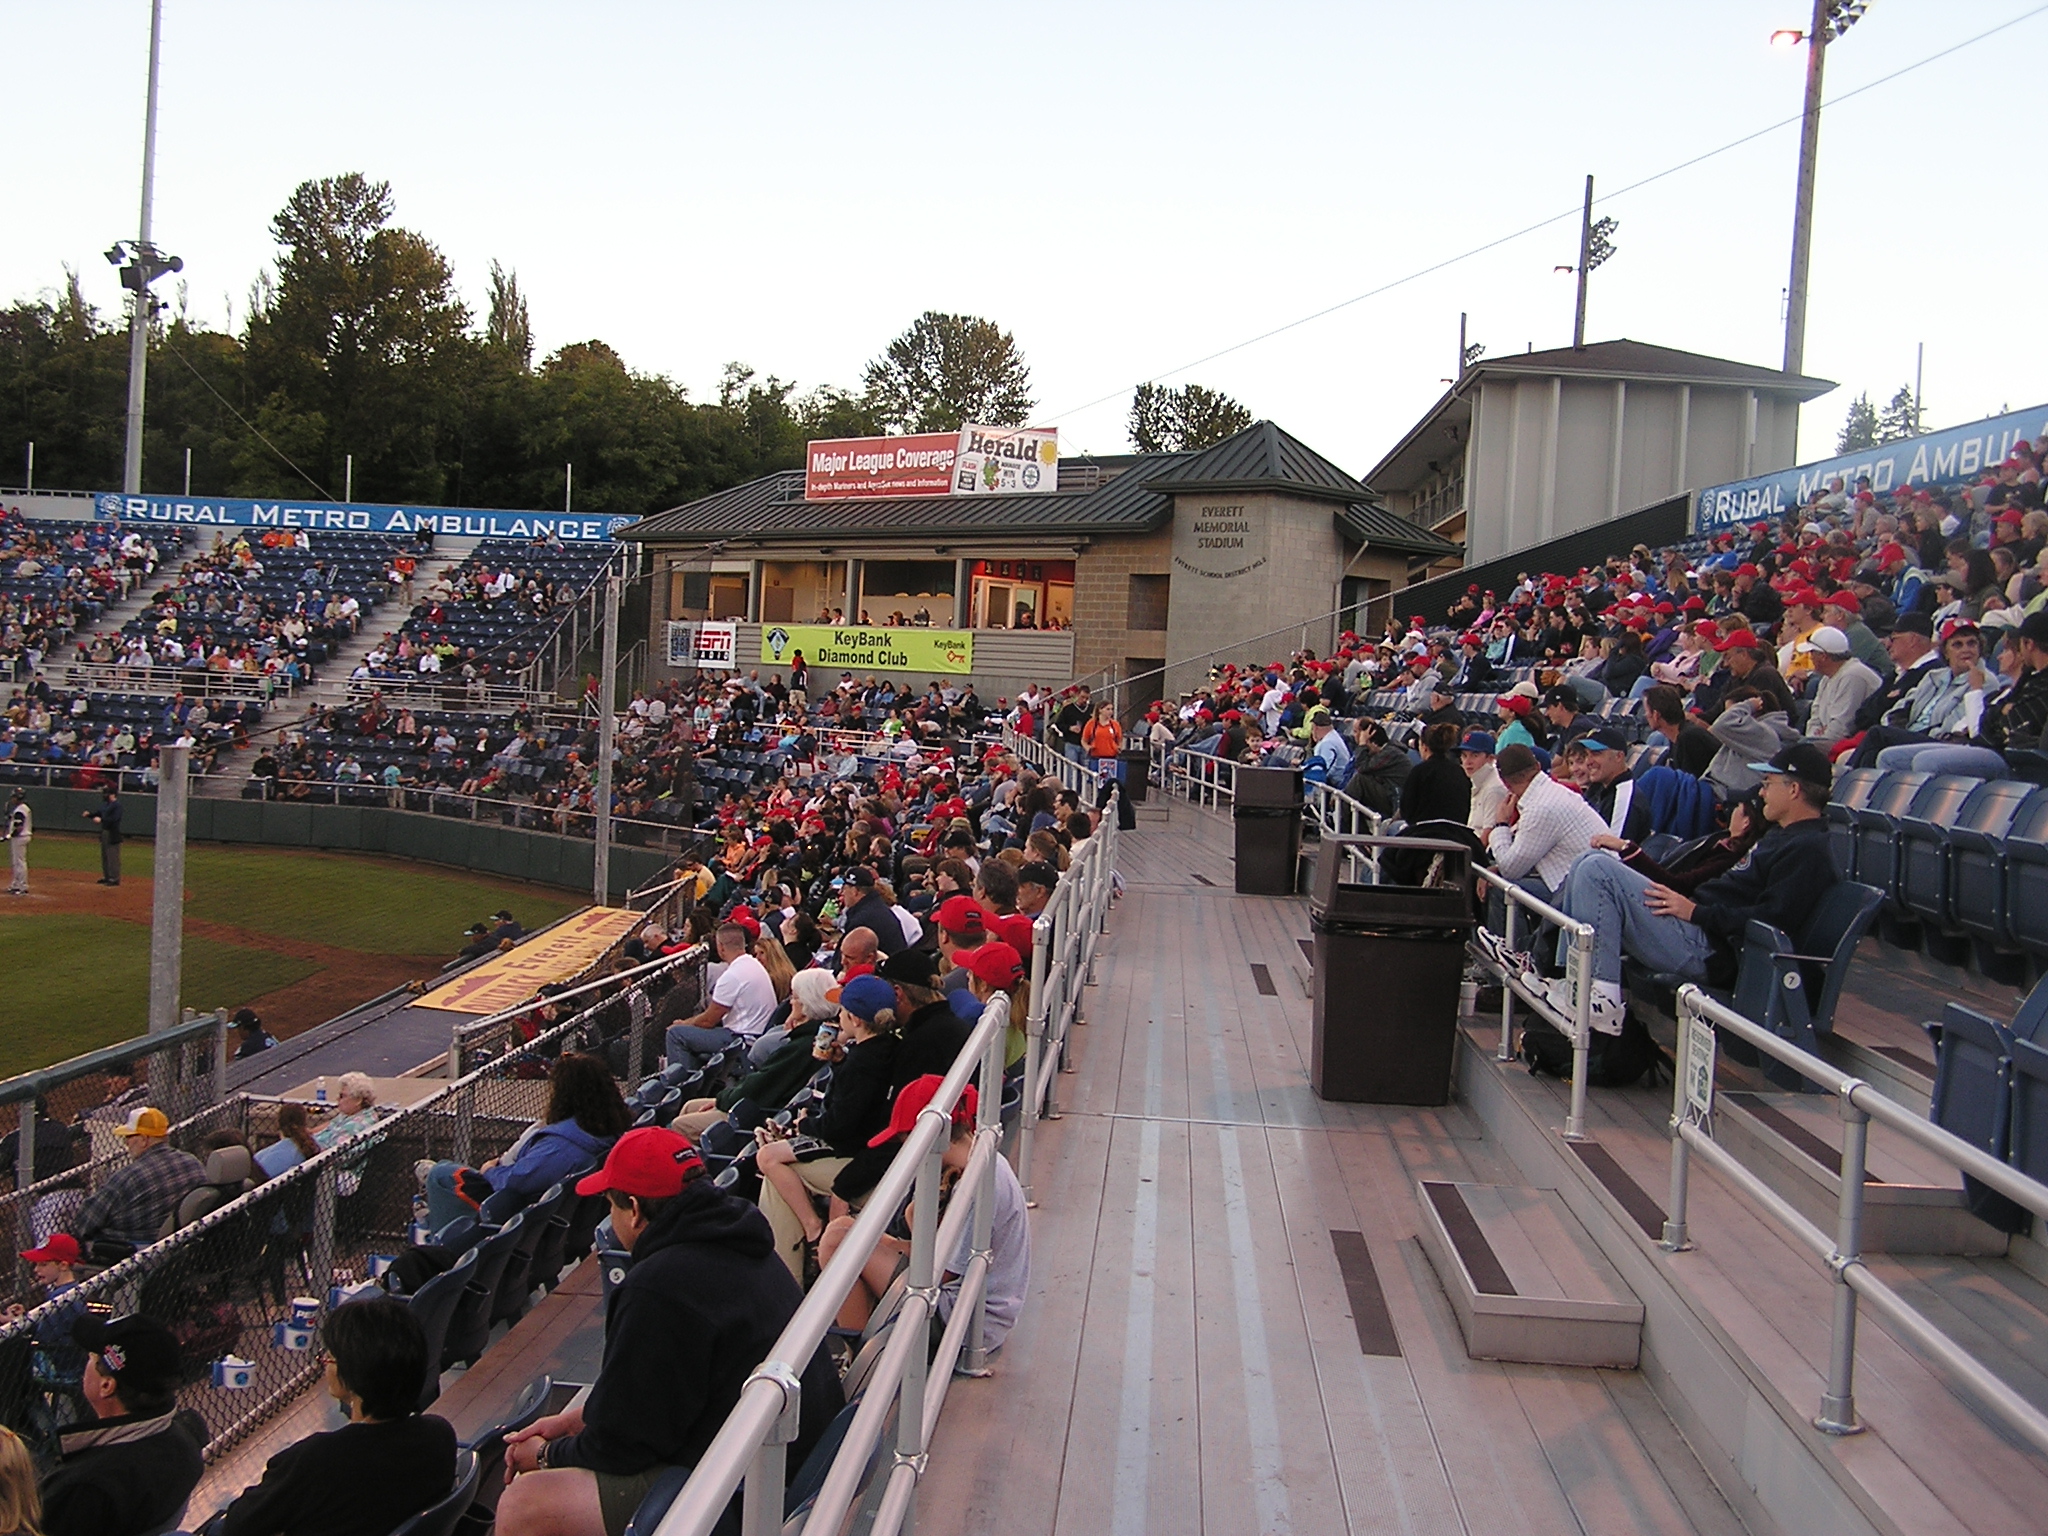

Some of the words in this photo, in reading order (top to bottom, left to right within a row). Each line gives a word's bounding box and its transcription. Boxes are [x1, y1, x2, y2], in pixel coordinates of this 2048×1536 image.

[968, 431, 1038, 462] Herald
[812, 452, 847, 476] Major
[849, 451, 894, 475] League
[896, 448, 955, 471] Coverage
[857, 480, 867, 489] and
[906, 479, 917, 487] and
[1201, 506, 1245, 517] EVERETT
[1714, 484, 1786, 524] RURAL
[125, 498, 236, 524] RURAL
[252, 503, 371, 529] METRO
[385, 509, 601, 540] AMBULANCE
[1193, 522, 1250, 533] MEMORIAL
[1198, 537, 1244, 548] STADIUM
[1174, 556, 1199, 574] EVERETT
[1200, 570, 1223, 578] SCHOOL
[1225, 565, 1252, 578] DISTRICT
[693, 630, 731, 649] ESPN
[834, 631, 892, 649] KeyBank
[934, 640, 966, 650] KeyBank
[818, 648, 874, 664] Diamond
[878, 651, 908, 666] Club
[503, 935, 588, 970] Everett
[1789, 976, 1795, 986] 7
[613, 1271, 620, 1281] 5
